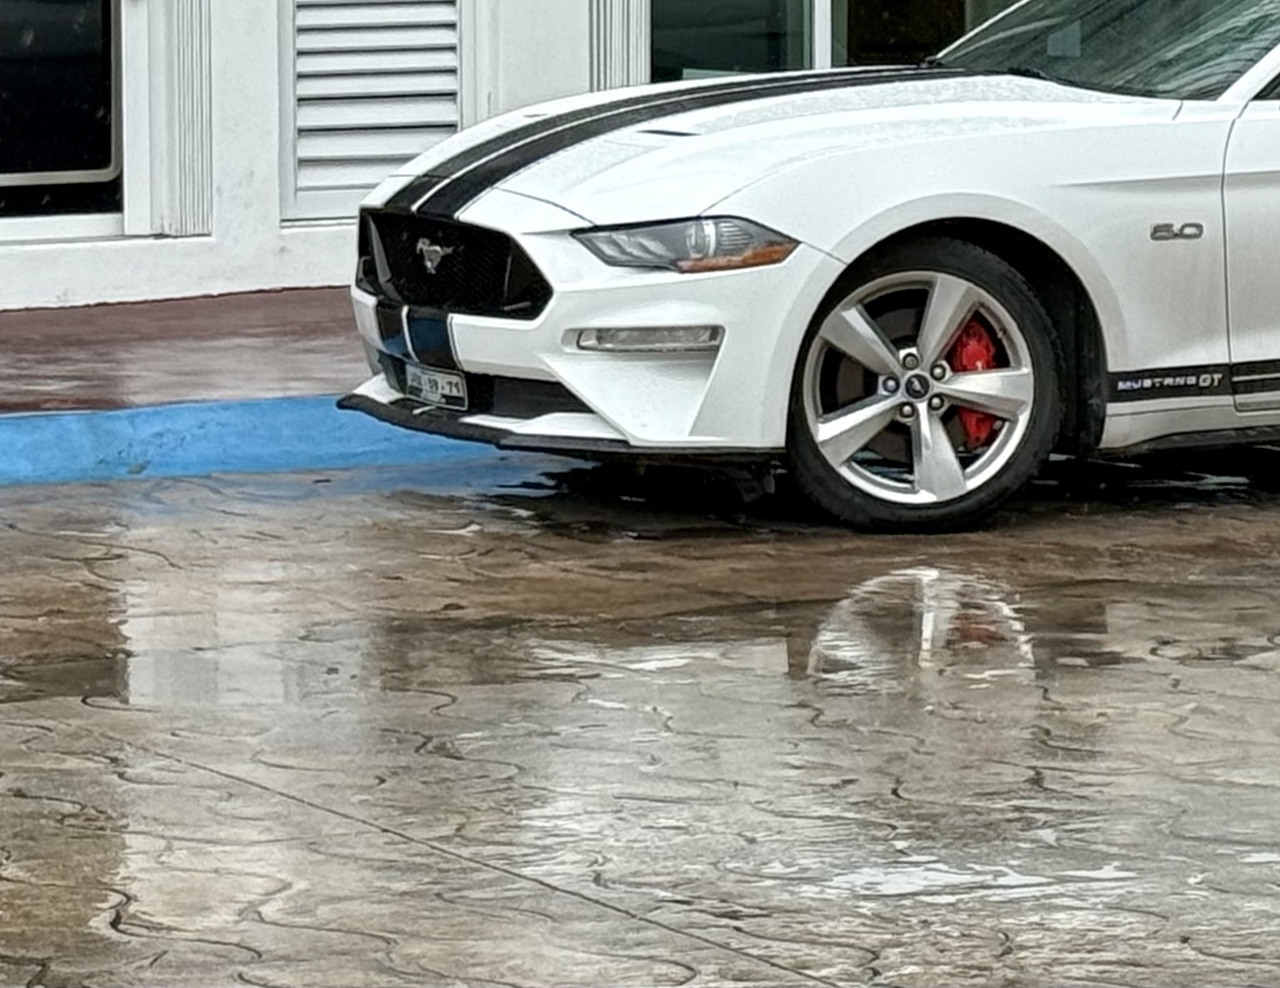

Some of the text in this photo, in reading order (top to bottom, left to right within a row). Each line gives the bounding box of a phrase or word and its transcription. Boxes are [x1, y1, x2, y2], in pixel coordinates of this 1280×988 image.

[1150, 223, 1204, 241] 5.0
[1117, 373, 1223, 391] MUSTANG GT
